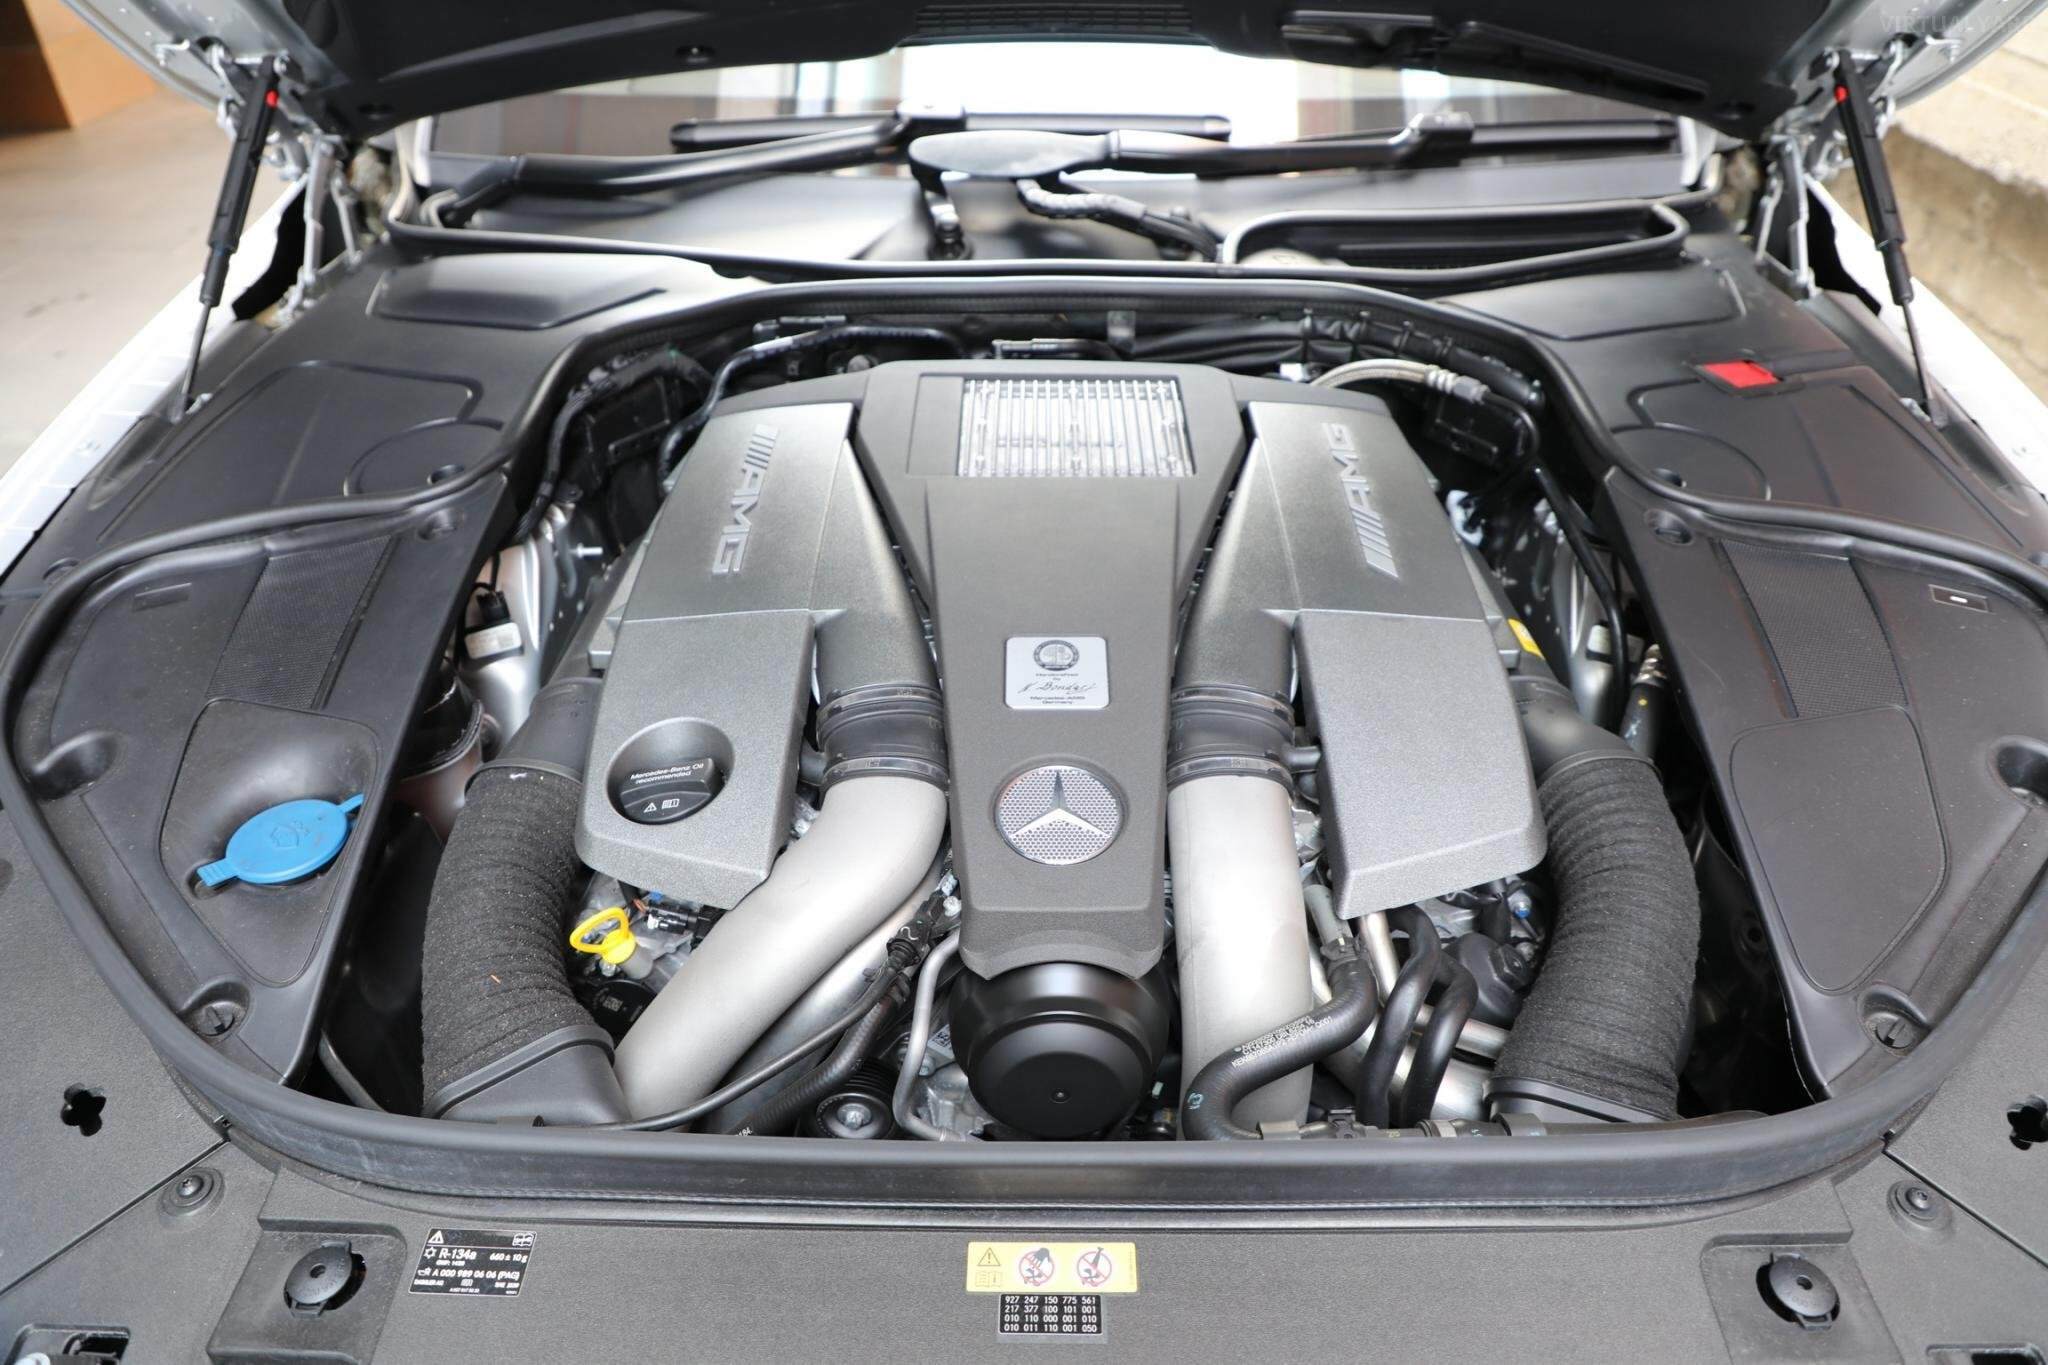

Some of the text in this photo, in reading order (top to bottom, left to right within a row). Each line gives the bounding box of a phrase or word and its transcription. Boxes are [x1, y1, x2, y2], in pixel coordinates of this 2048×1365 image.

[712, 461, 768, 574] AMG
[630, 765, 691, 780] Mercedes-Benz
[635, 771, 692, 785] recommended
[439, 1248, 477, 1260] R-134a
[512, 1253, 521, 1261] 10
[432, 1268, 520, 1280] A 000 989 06 06 (PAG)
[1005, 1296, 1095, 1304] 927 247 150 775 561
[1005, 1305, 1095, 1313] 217 377 100 101 001
[1004, 1314, 1097, 1323] 010 110 000 001 010
[1004, 1324, 1097, 1332] 010 011 110 001 050
